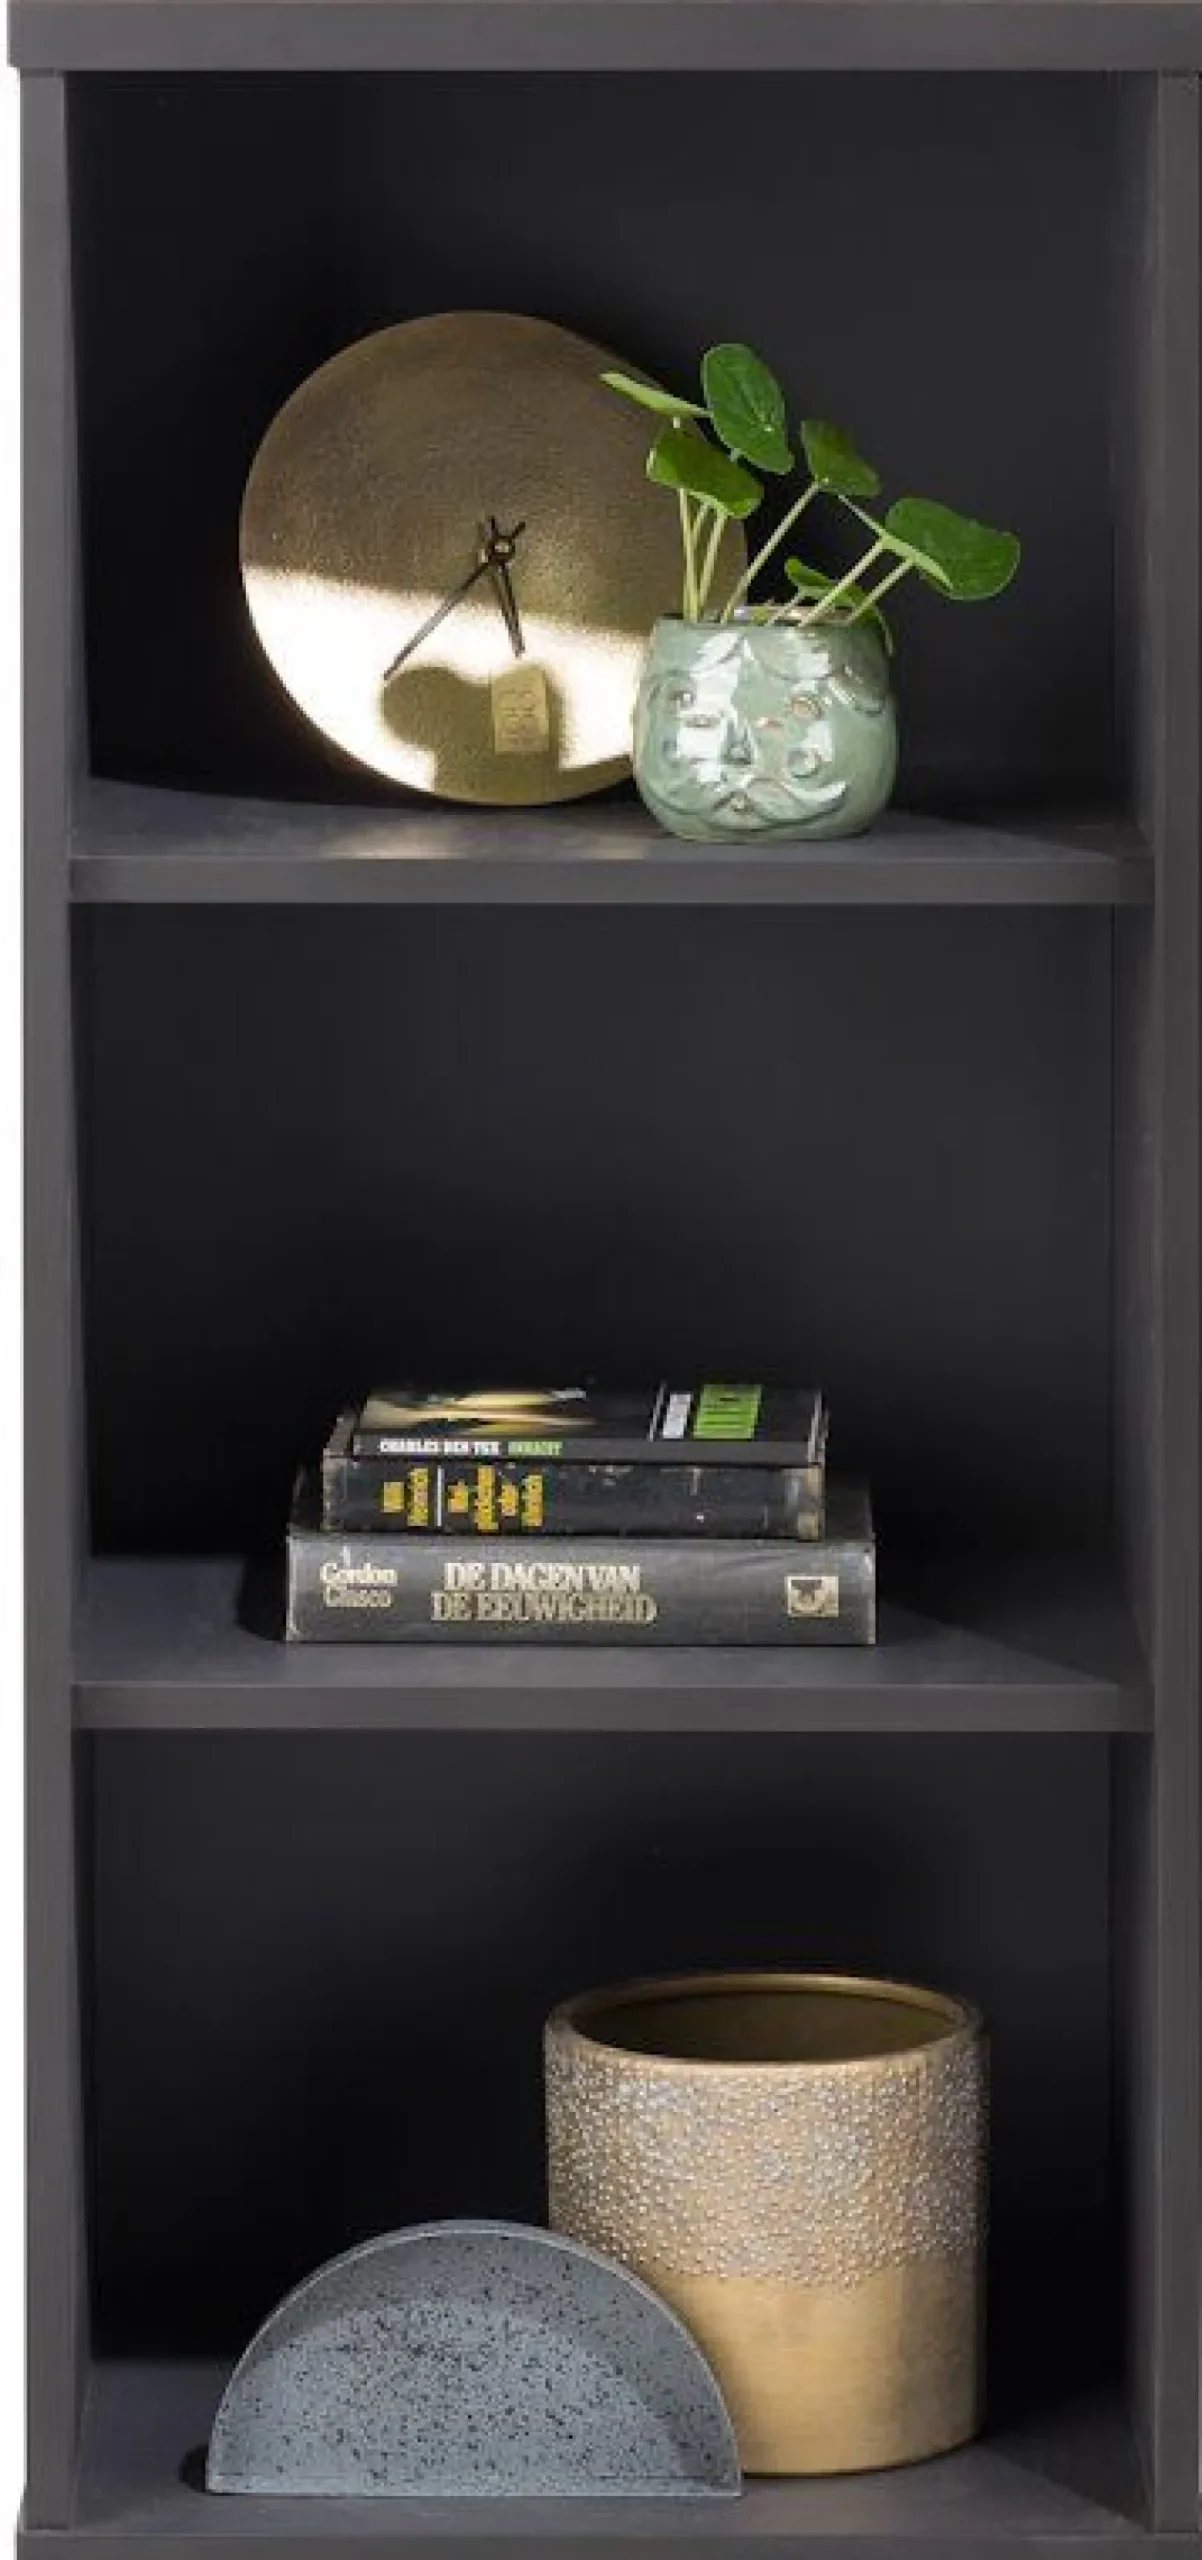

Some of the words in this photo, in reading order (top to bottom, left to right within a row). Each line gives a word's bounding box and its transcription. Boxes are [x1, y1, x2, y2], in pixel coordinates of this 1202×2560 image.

[379, 1439, 438, 1456] CHARLES
[444, 1440, 469, 1456] DEN
[320, 1561, 398, 1586] Gordon
[444, 1562, 485, 1590] DE
[490, 1562, 583, 1592] DAGEN
[583, 1563, 641, 1592] VAN
[431, 1591, 473, 1621] DE
[476, 1592, 657, 1623] EEUWIGHEID
